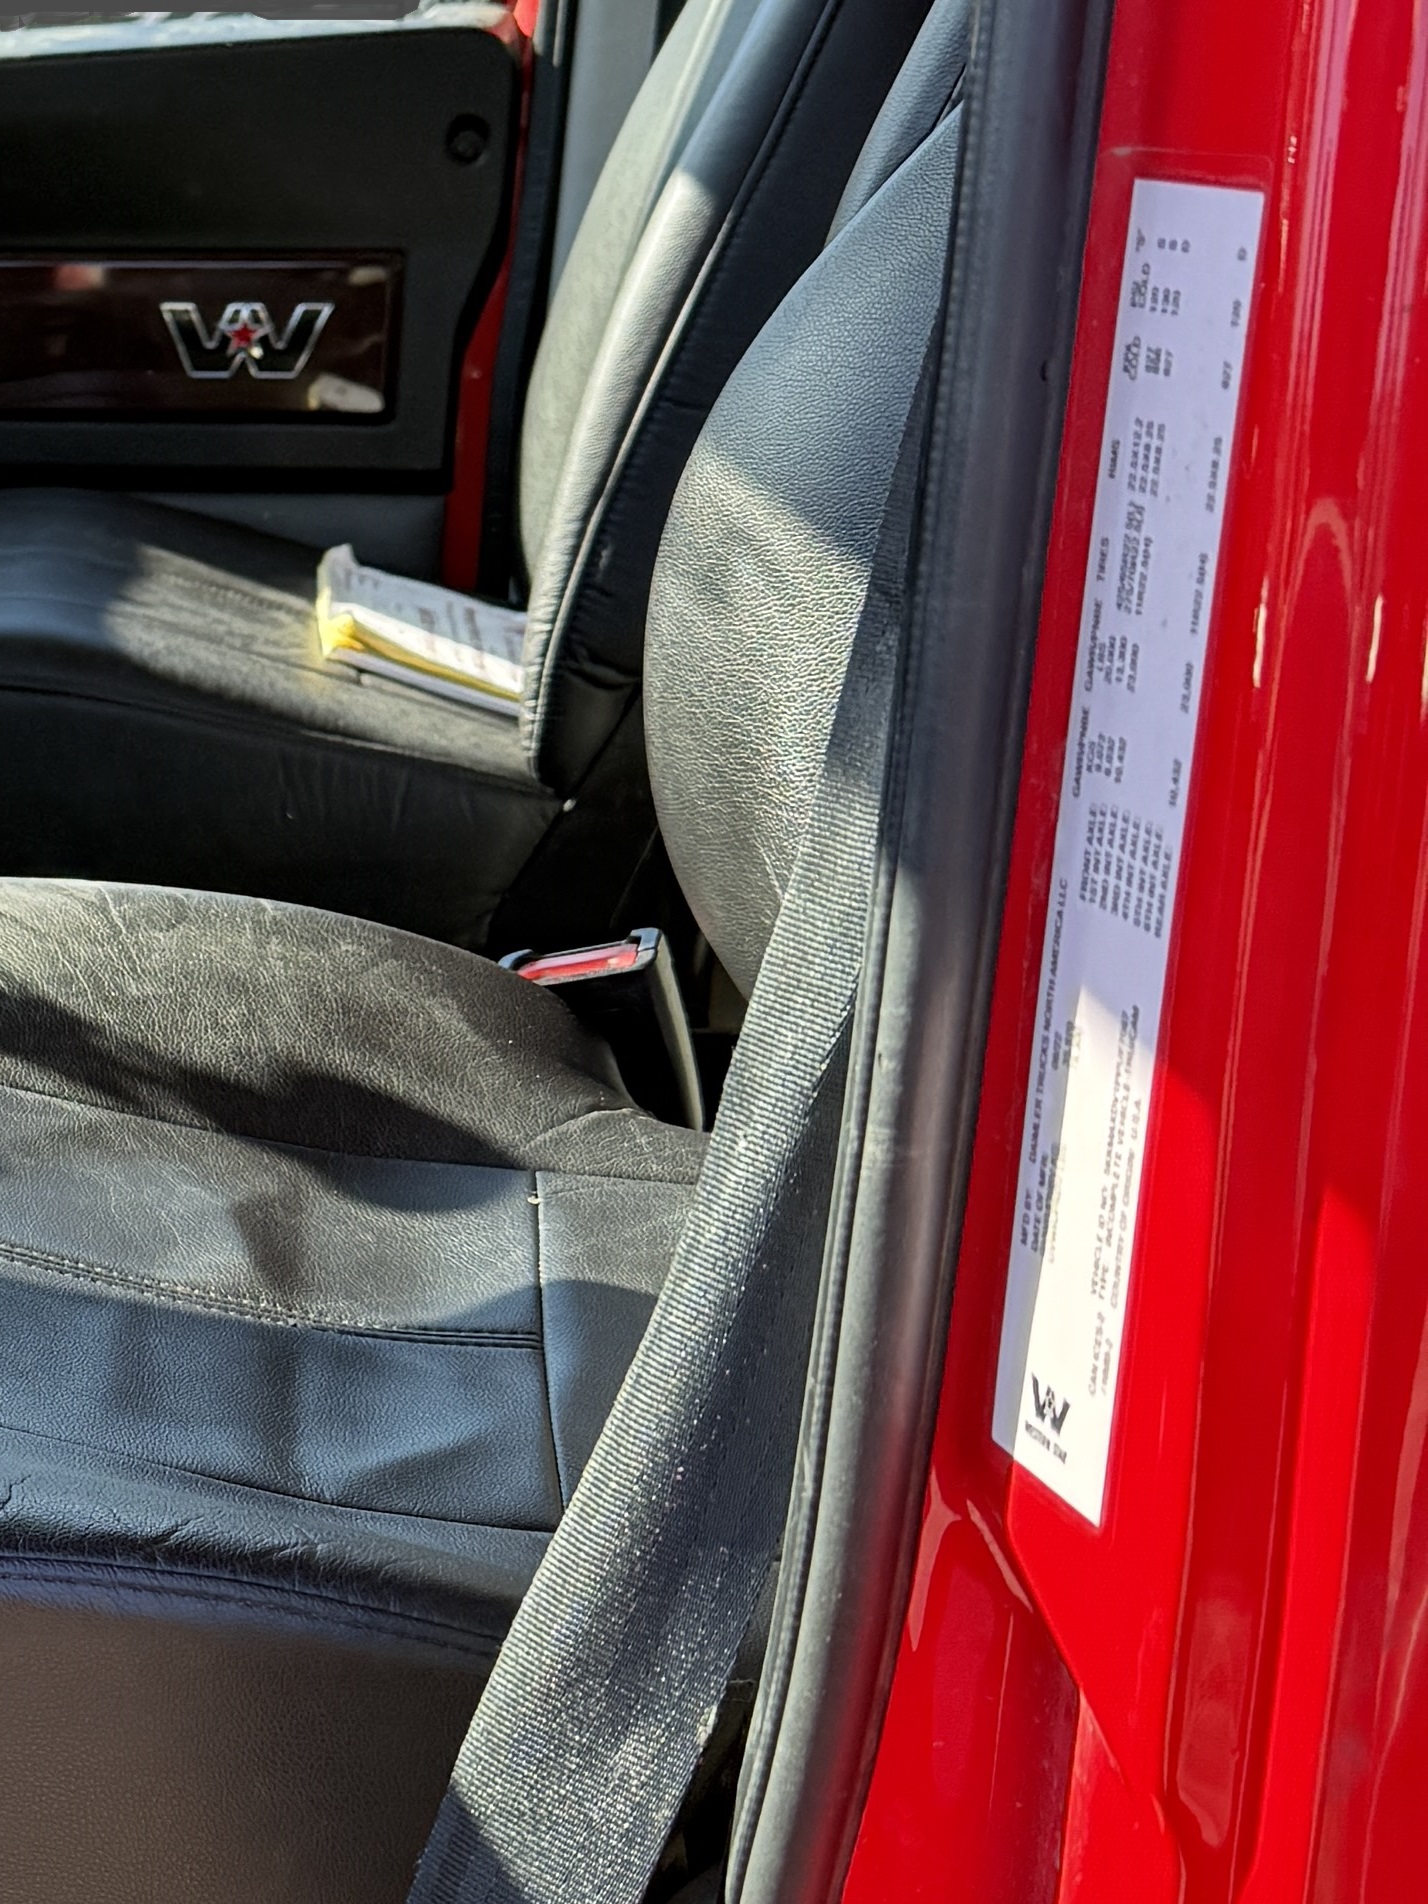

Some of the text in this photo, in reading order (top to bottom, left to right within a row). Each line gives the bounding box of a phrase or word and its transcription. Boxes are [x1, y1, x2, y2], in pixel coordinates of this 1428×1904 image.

[1056, 876, 1067, 908] LLC
[1049, 907, 1064, 978] AMERICA
[1043, 977, 1056, 1033] NORTH
[1035, 1032, 1050, 1097] TRUCKS
[1028, 1096, 1043, 1164] DAIMLER
[1034, 1189, 1044, 1213] OF
[1030, 1213, 1041, 1254] DATE
[1089, 1233, 1103, 1297] VEHICLE
